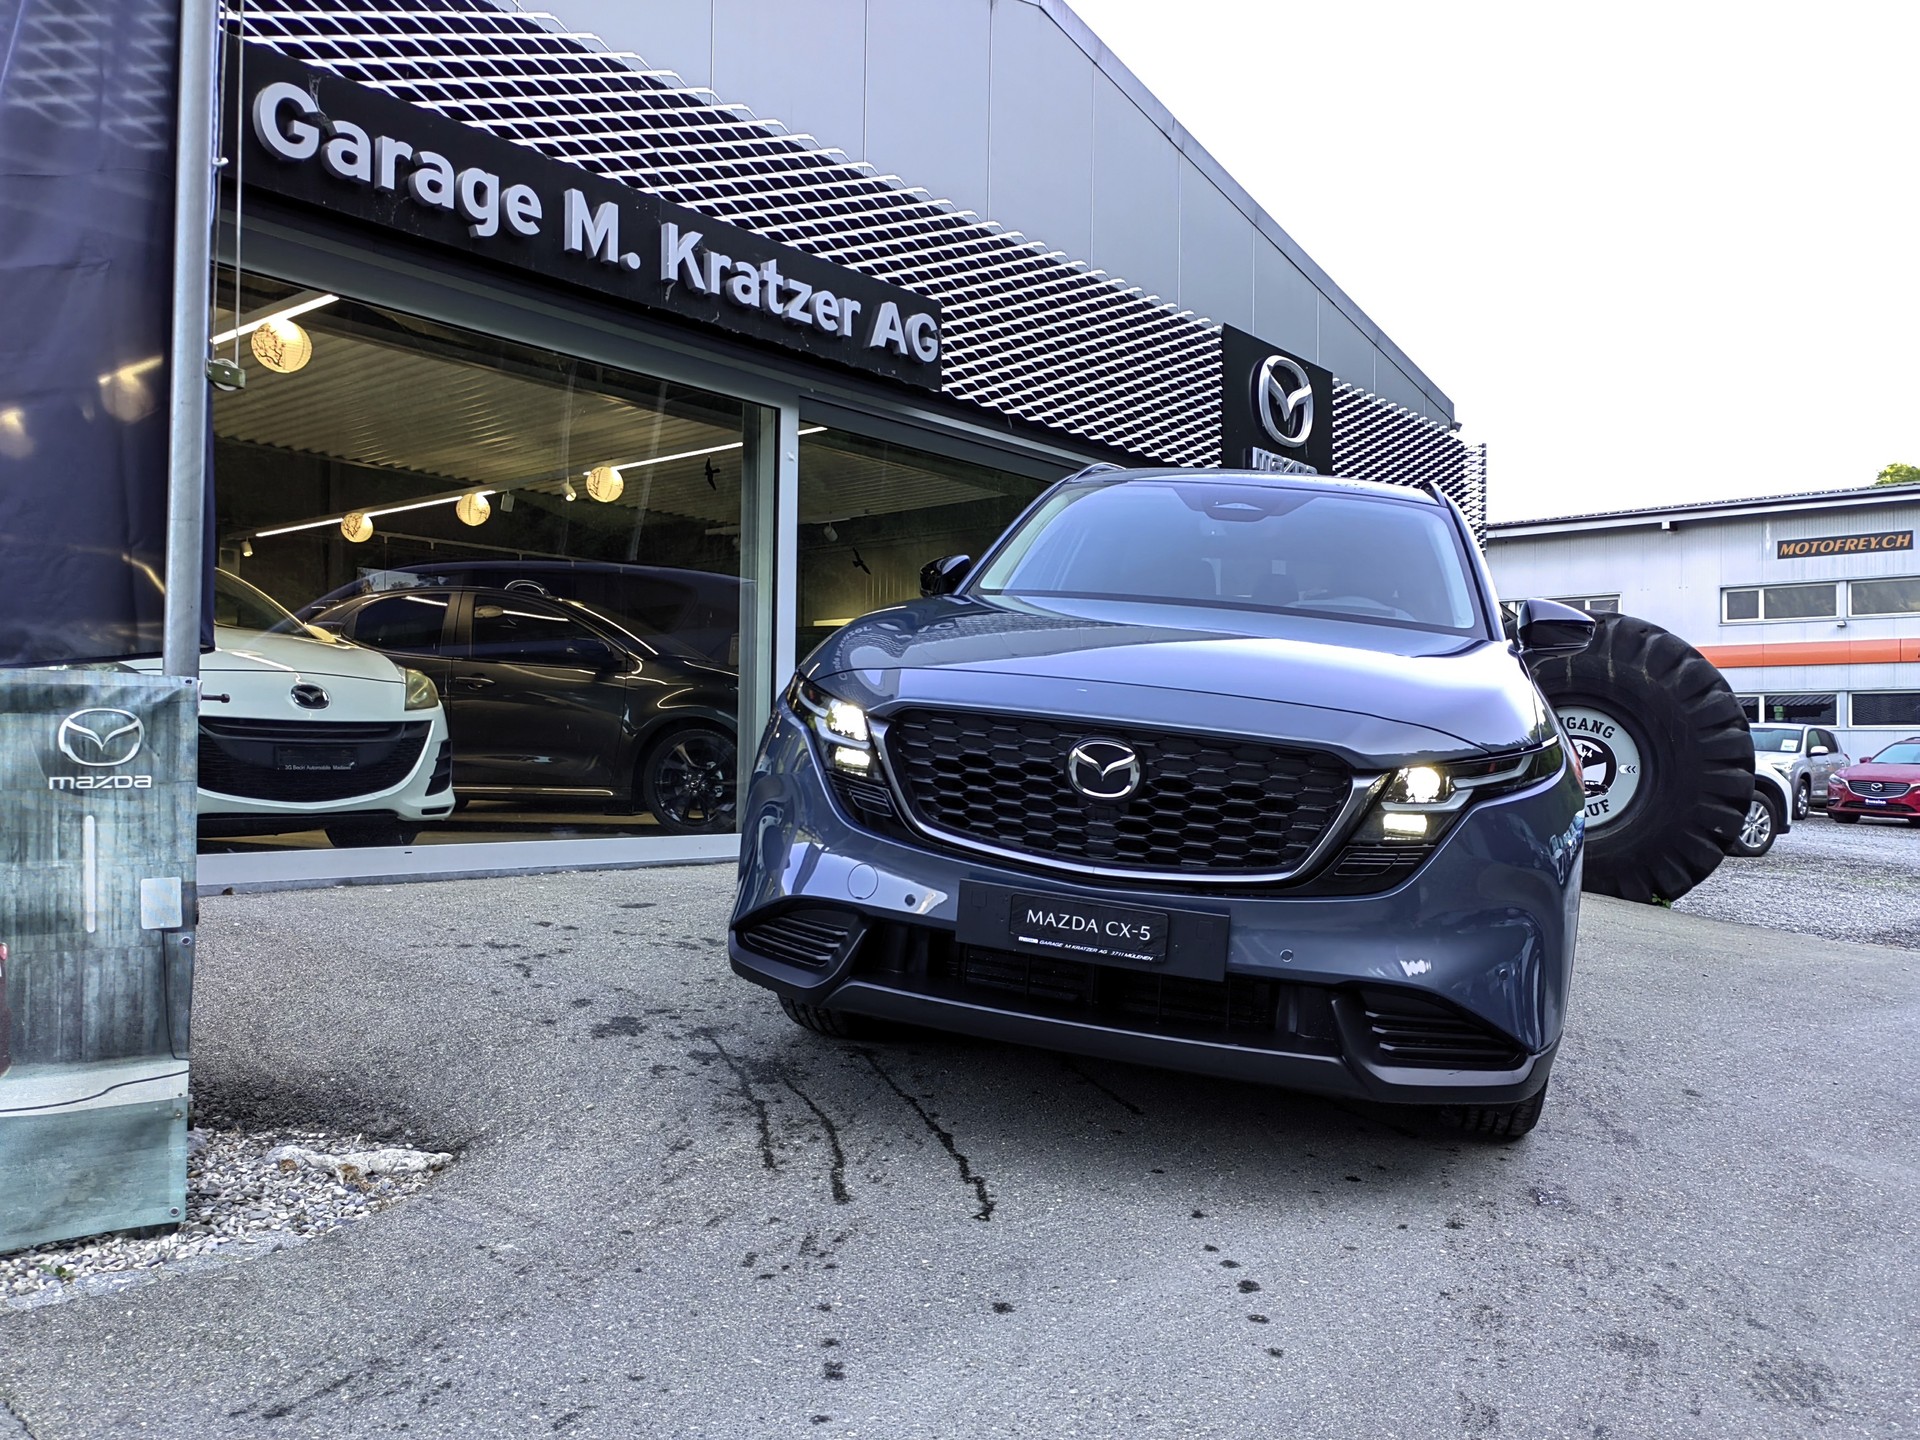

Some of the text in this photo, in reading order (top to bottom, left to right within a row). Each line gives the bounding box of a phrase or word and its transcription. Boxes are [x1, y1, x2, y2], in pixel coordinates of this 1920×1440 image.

[252, 82, 939, 364] Garage M. Kratzer AG
[1780, 534, 1911, 556] MOTOFREY.CH
[1560, 716, 1616, 739] GANG
[1584, 799, 1610, 818] UF
[1026, 909, 1151, 941] MAZDA CX-5
